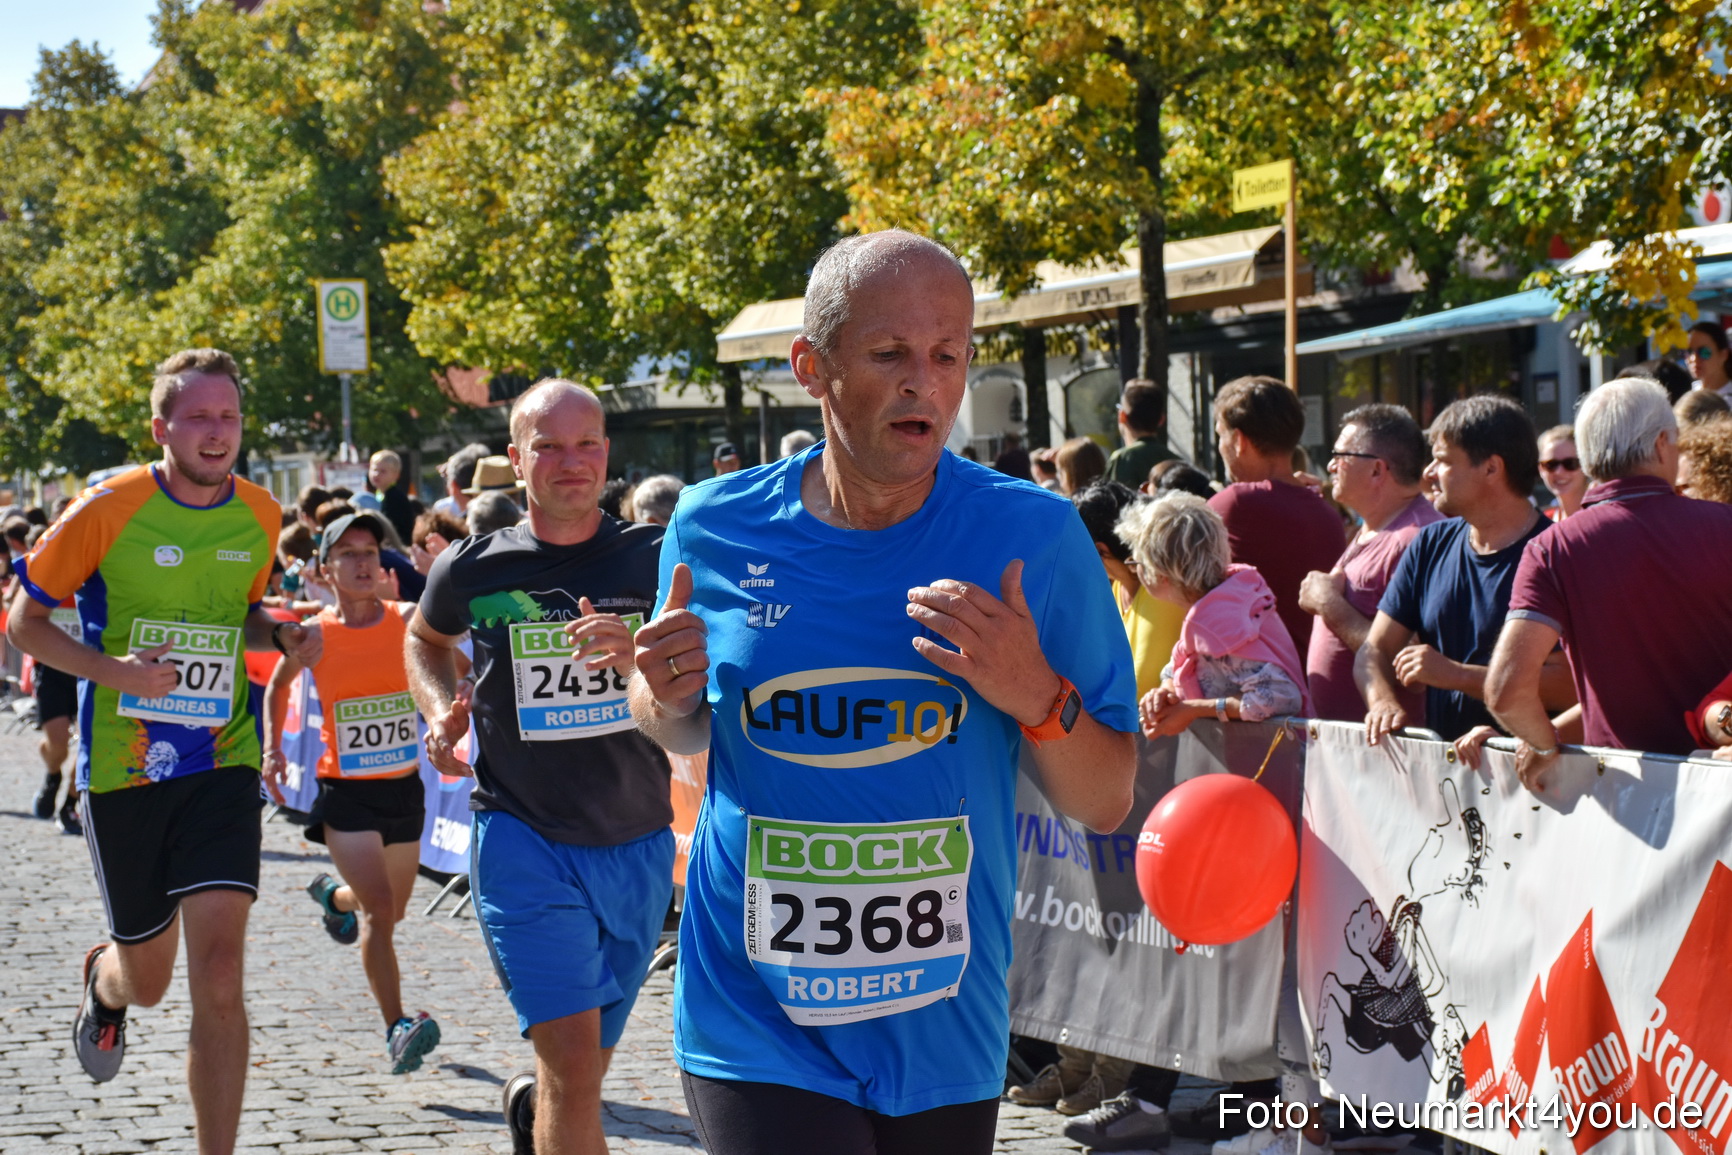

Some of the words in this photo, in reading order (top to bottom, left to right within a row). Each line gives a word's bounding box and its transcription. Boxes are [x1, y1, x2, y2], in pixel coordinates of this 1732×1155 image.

[1244, 178, 1287, 197] Toiletten
[335, 295, 351, 312] H
[217, 550, 252, 562] BOCK
[739, 577, 775, 589] erima
[139, 624, 230, 653] BOCK
[153, 658, 223, 691] 507
[136, 697, 217, 715] ANDREAS
[341, 695, 408, 720] BOCK
[545, 704, 631, 726] ROBERT
[741, 687, 963, 745] LAUF10!
[347, 719, 410, 749] 2076
[359, 750, 406, 767] NICOLE
[763, 827, 952, 876] BOCK
[770, 890, 945, 955] 2368
[787, 968, 925, 1001] ROBERT
[1550, 1031, 1628, 1112] Braun
